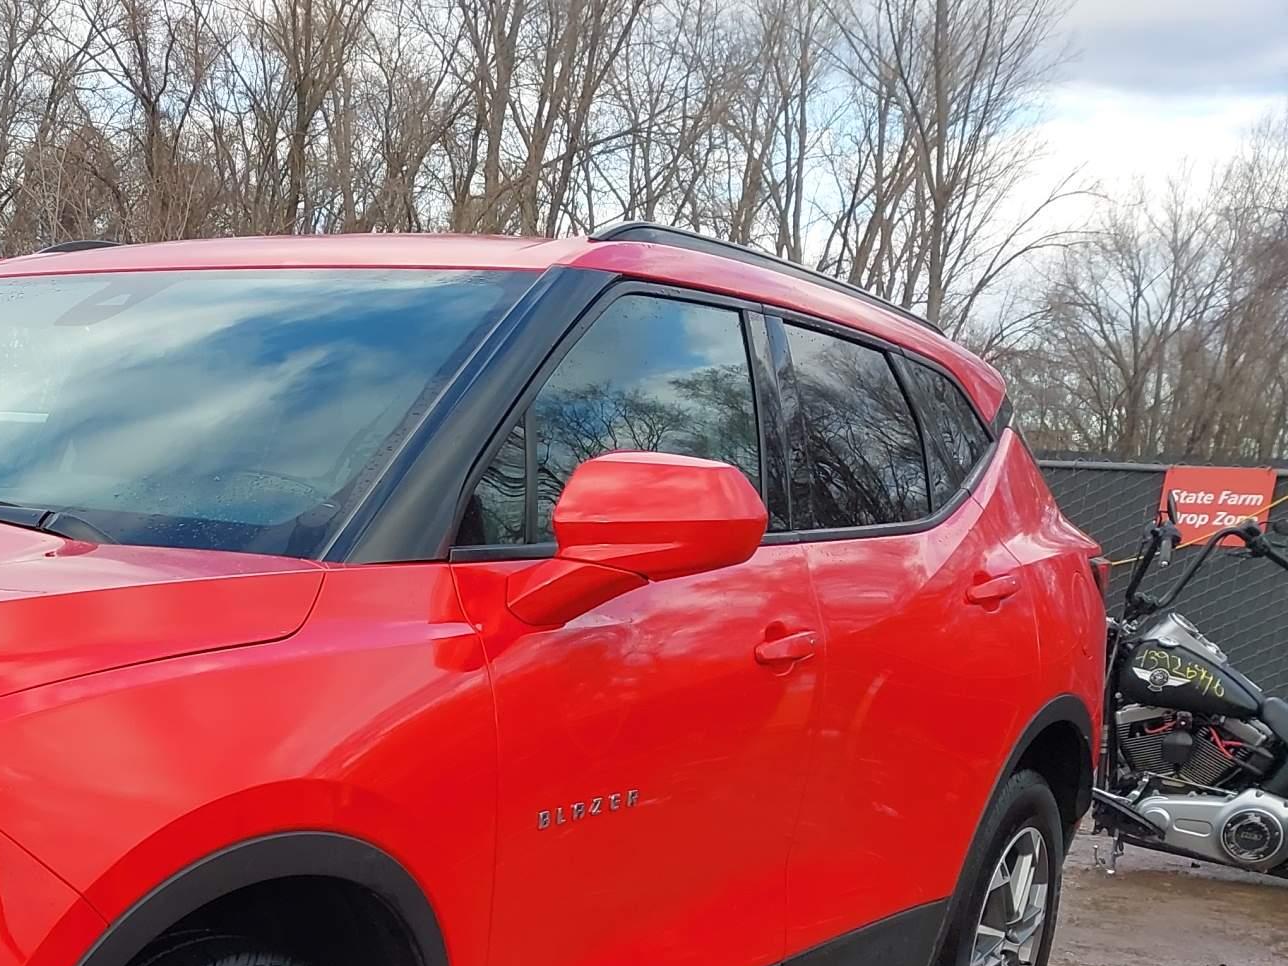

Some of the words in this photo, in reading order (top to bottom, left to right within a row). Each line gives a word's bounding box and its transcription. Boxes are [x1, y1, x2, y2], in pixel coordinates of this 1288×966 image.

[1172, 489, 1214, 505] State
[1218, 490, 1264, 506] Farm
[1176, 511, 1210, 529] rop
[537, 789, 639, 831] BLAZER
